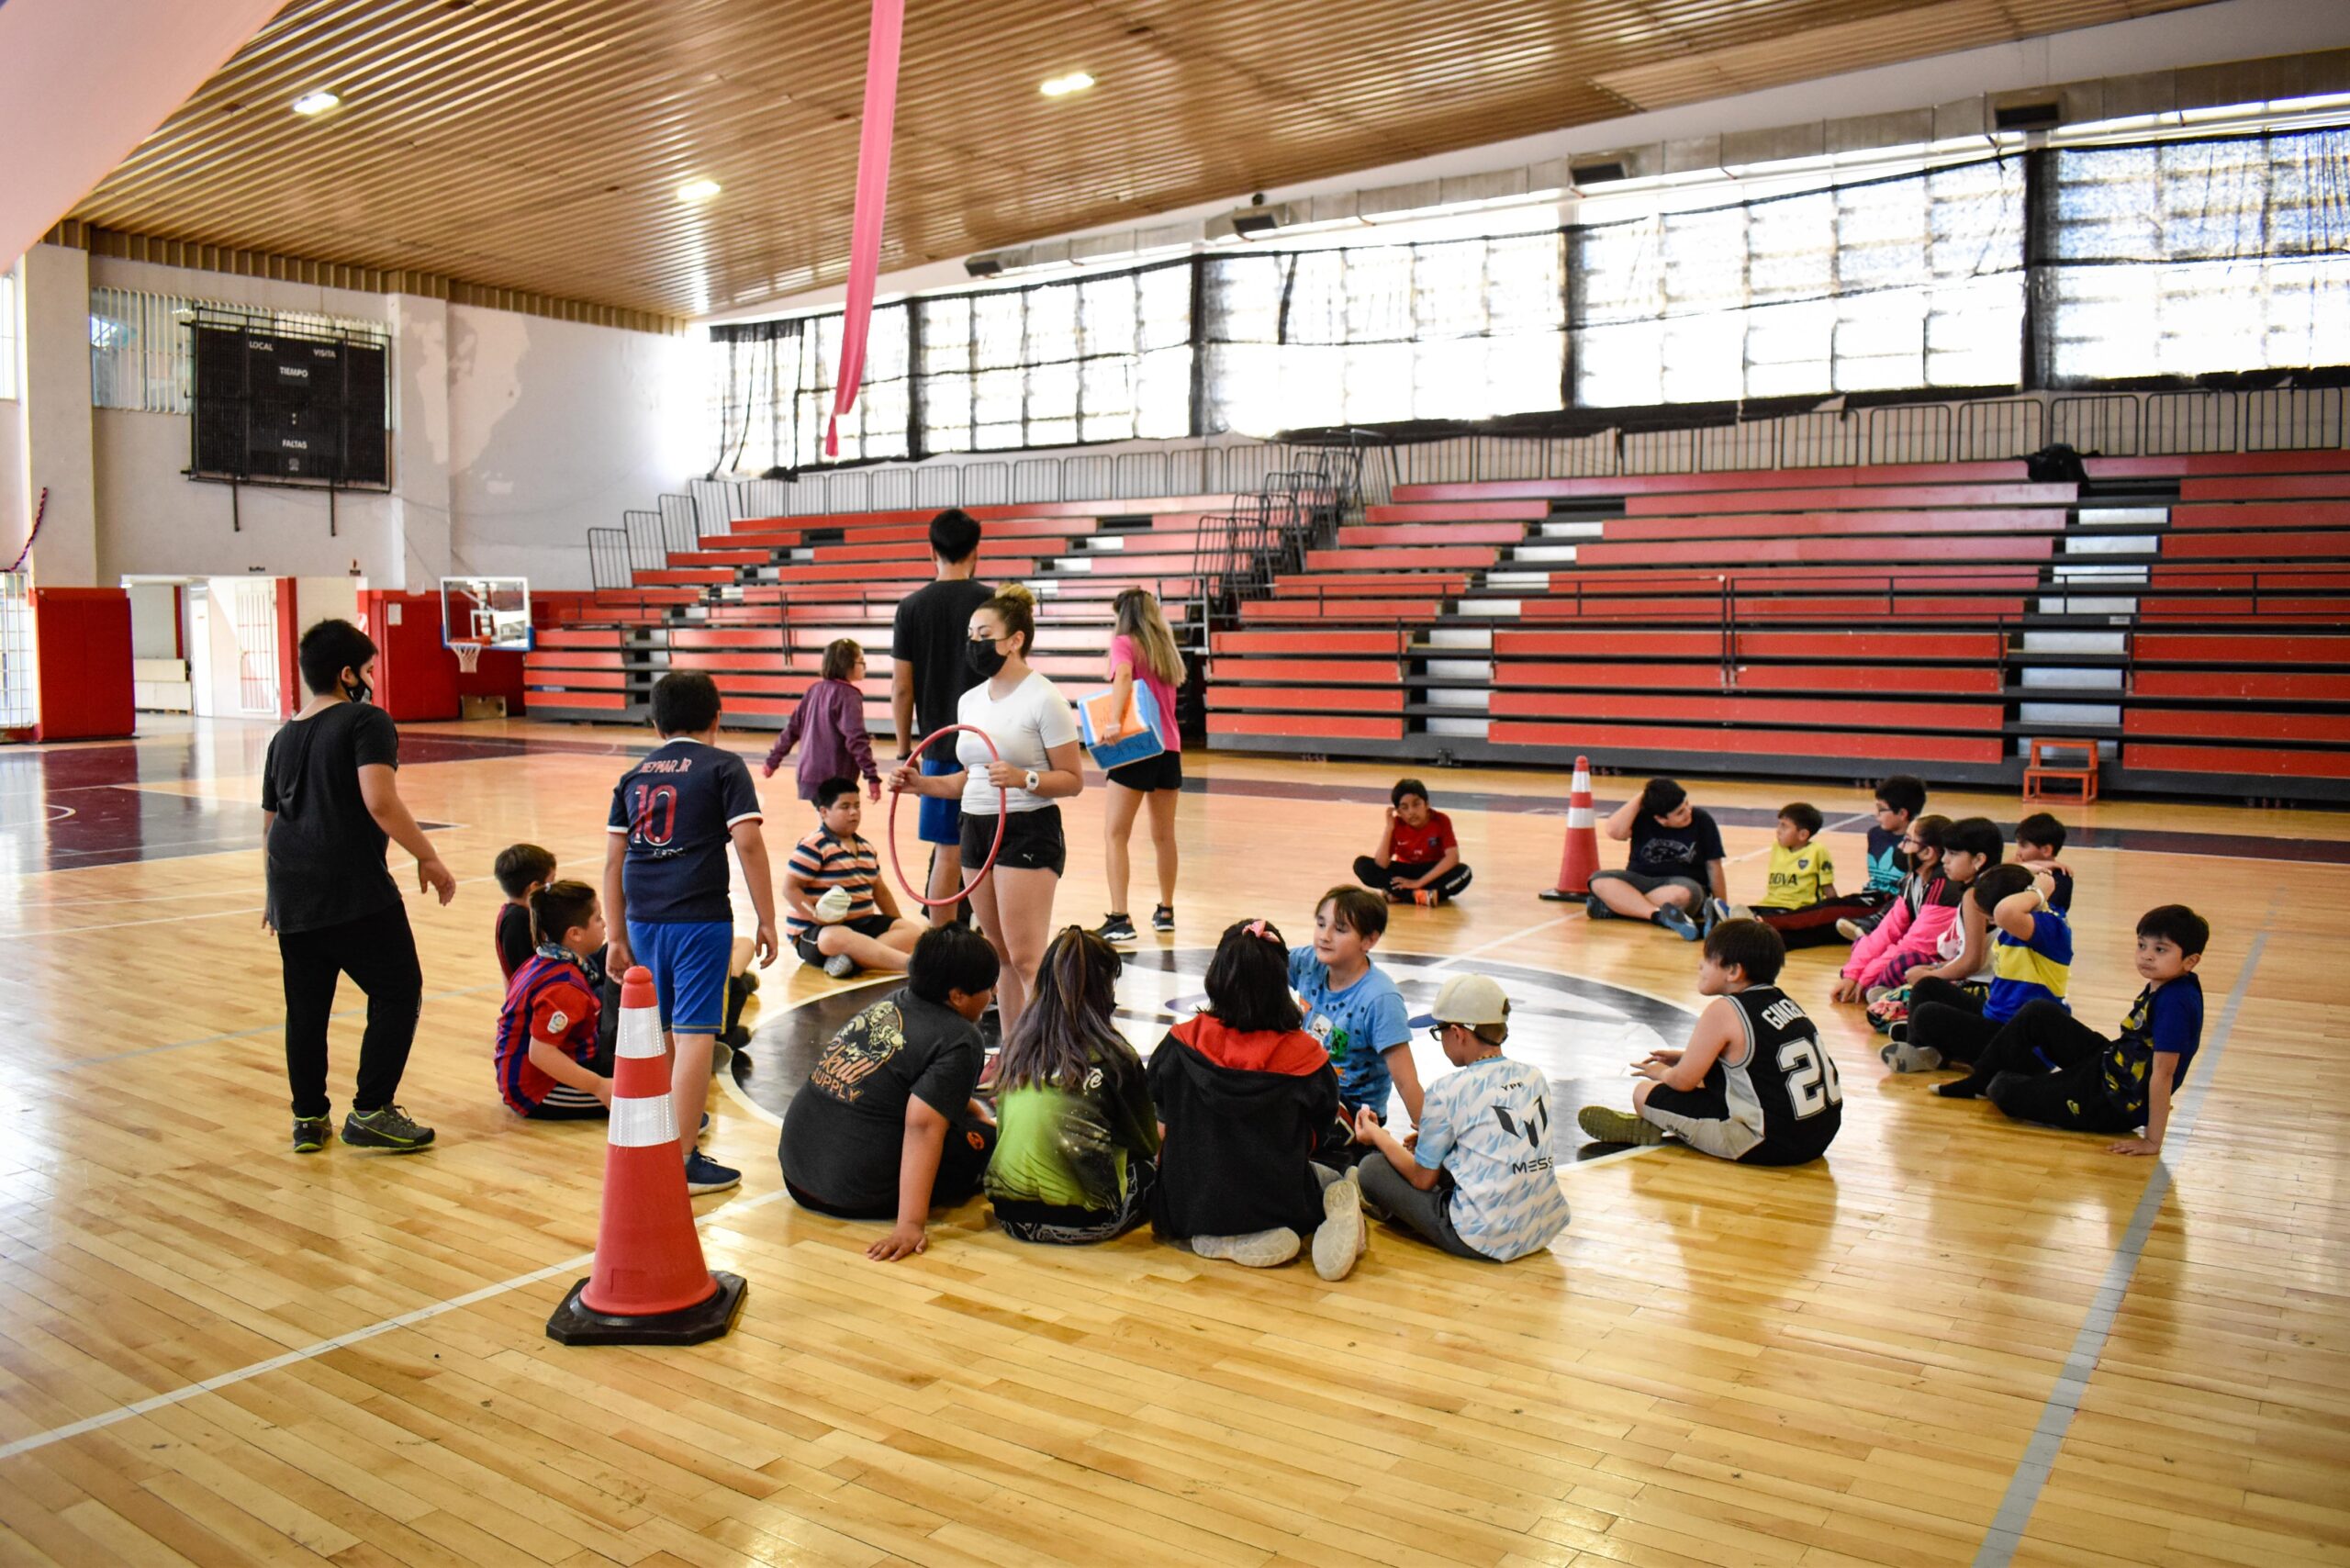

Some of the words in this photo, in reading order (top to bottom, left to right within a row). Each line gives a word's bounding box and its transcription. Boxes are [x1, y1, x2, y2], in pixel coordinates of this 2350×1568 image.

[249, 341, 274, 352] LOCAL
[313, 348, 336, 359] VISITA
[279, 366, 308, 378] TIEMPO
[282, 439, 308, 450] FALTAS
[639, 759, 678, 773] NEYMAR
[634, 784, 677, 846] 10
[810, 1068, 863, 1103] SUPPLY
